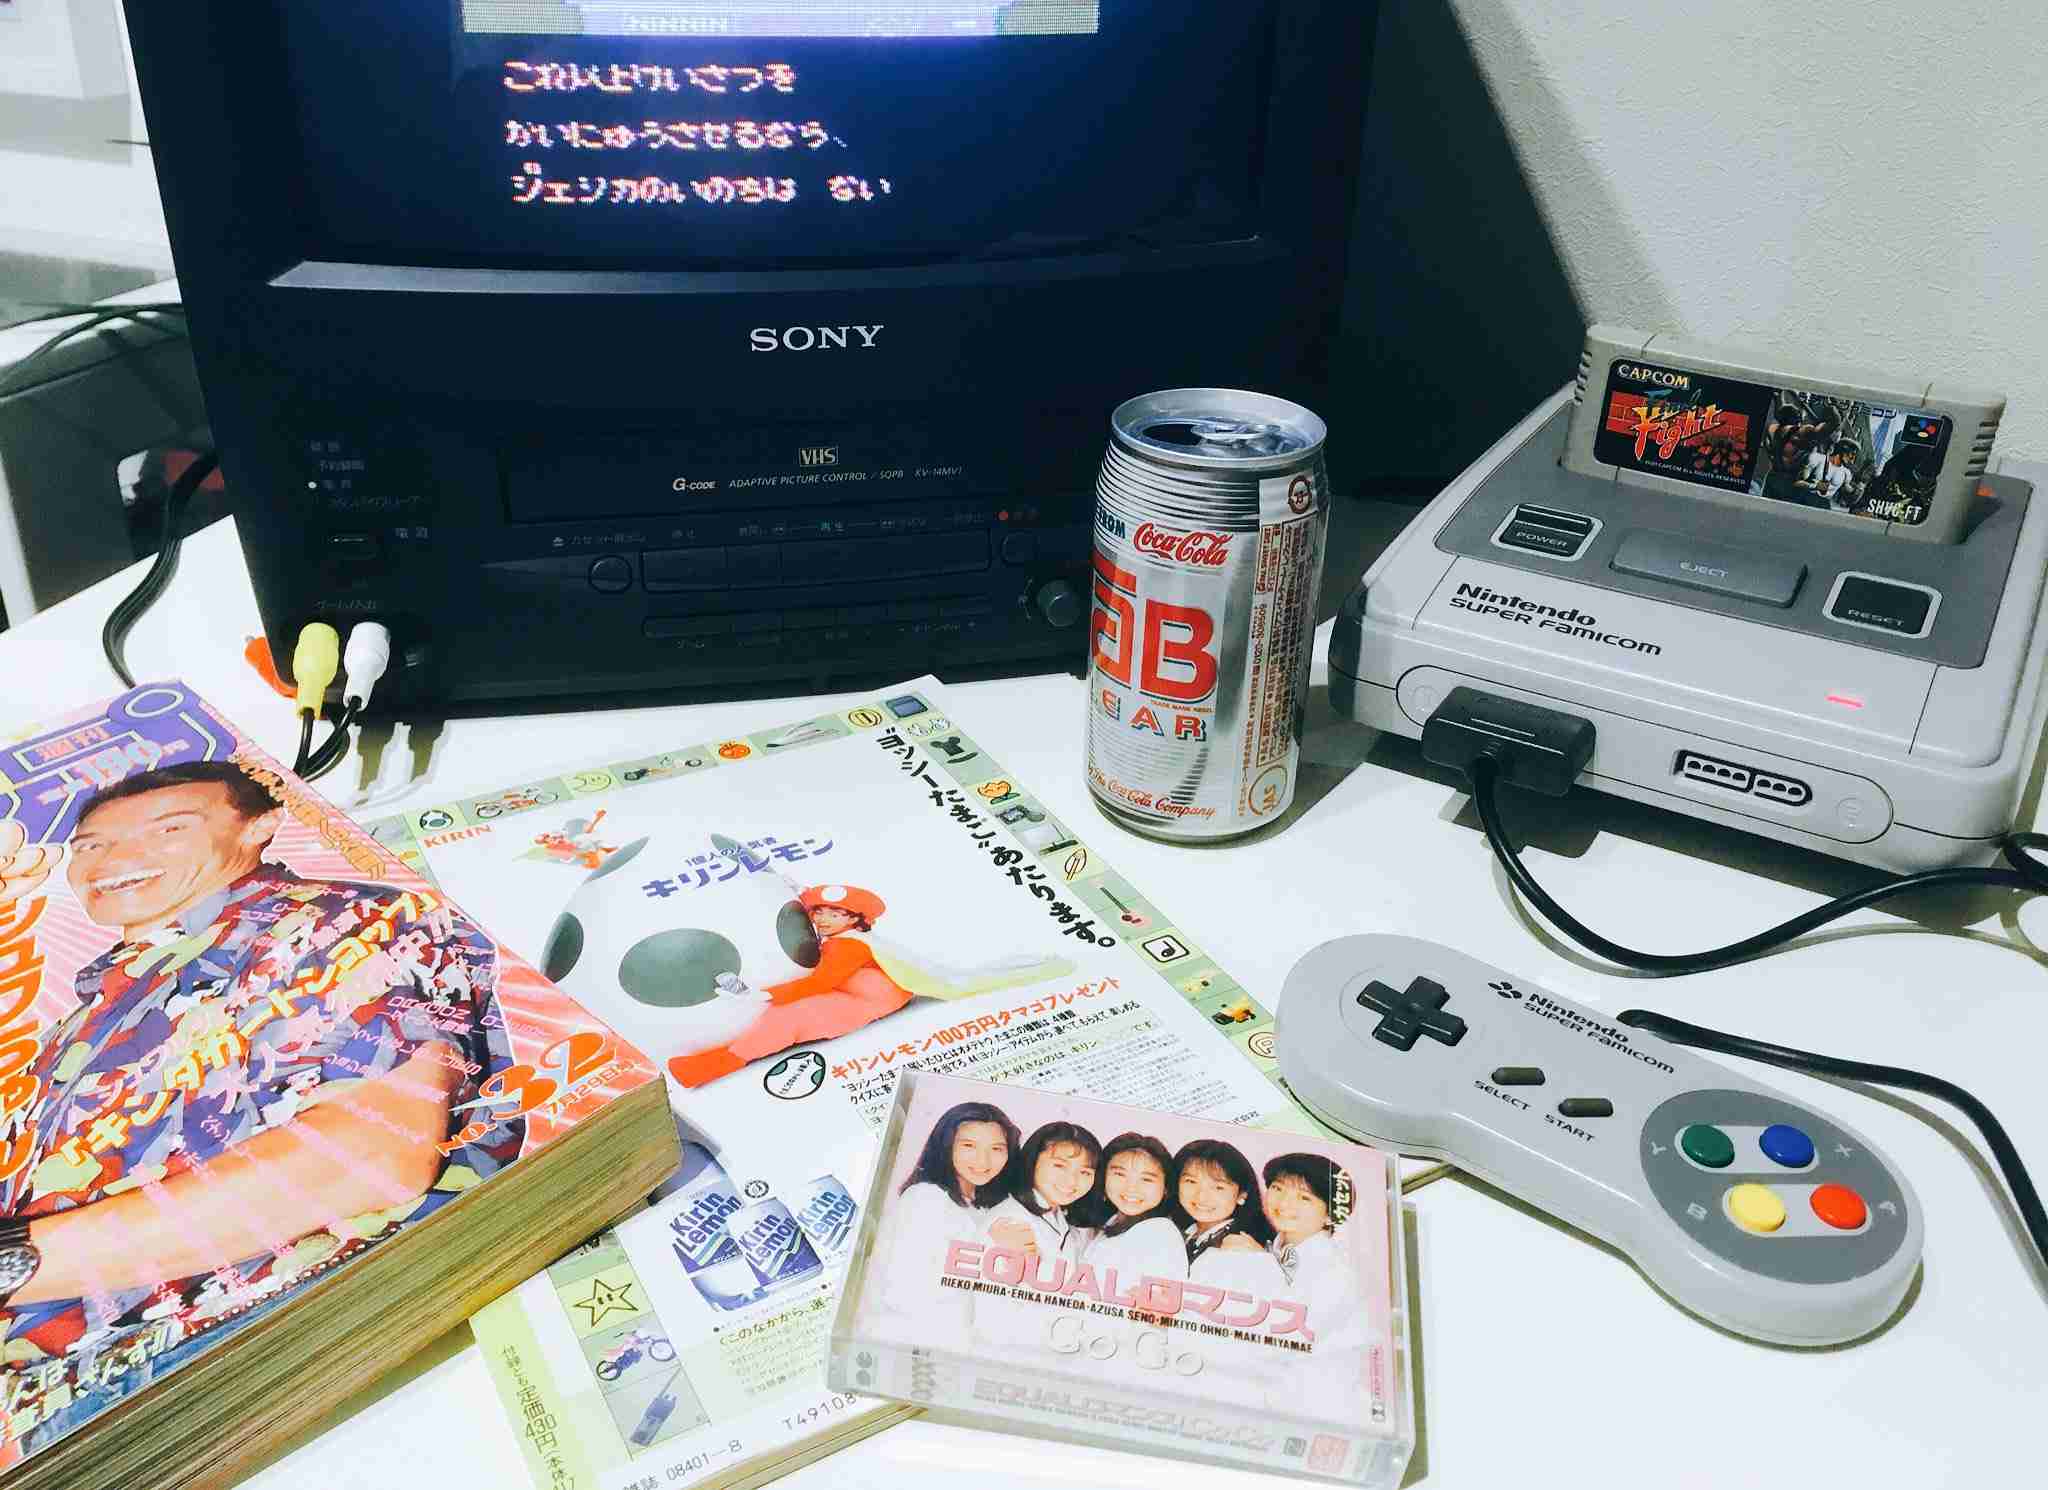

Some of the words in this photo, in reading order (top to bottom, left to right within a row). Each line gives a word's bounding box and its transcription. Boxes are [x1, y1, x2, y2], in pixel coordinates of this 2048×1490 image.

[750, 324, 885, 352] SONY
[1617, 363, 1690, 389] CAPCOM
[799, 447, 839, 466] VHS
[729, 476, 777, 489] ADAPTIVE
[780, 474, 819, 486] PICTURE
[822, 471, 867, 483] CONTROL
[1867, 498, 1923, 521] SHVC-FT
[1515, 531, 1569, 549] POWER
[1449, 597, 1534, 625] SUPER
[1456, 583, 1597, 627] Nintendo
[1154, 796, 1216, 820] Company
[423, 824, 493, 849] KIRIN
[641, 838, 834, 899] キリンレモン
[1523, 1001, 1583, 1033] SUPER
[1528, 993, 1629, 1044] Nintendo
[478, 1031, 617, 1121] 32
[1472, 1079, 1533, 1111] SELECT
[1543, 1113, 1597, 1143] START
[670, 1192, 725, 1236] Kirin
[678, 1194, 743, 1253] Lemon
[740, 1213, 781, 1251] Kirin
[940, 1276, 971, 1291] RIEKO
[1263, 1335, 1313, 1355] MIYAMAE
